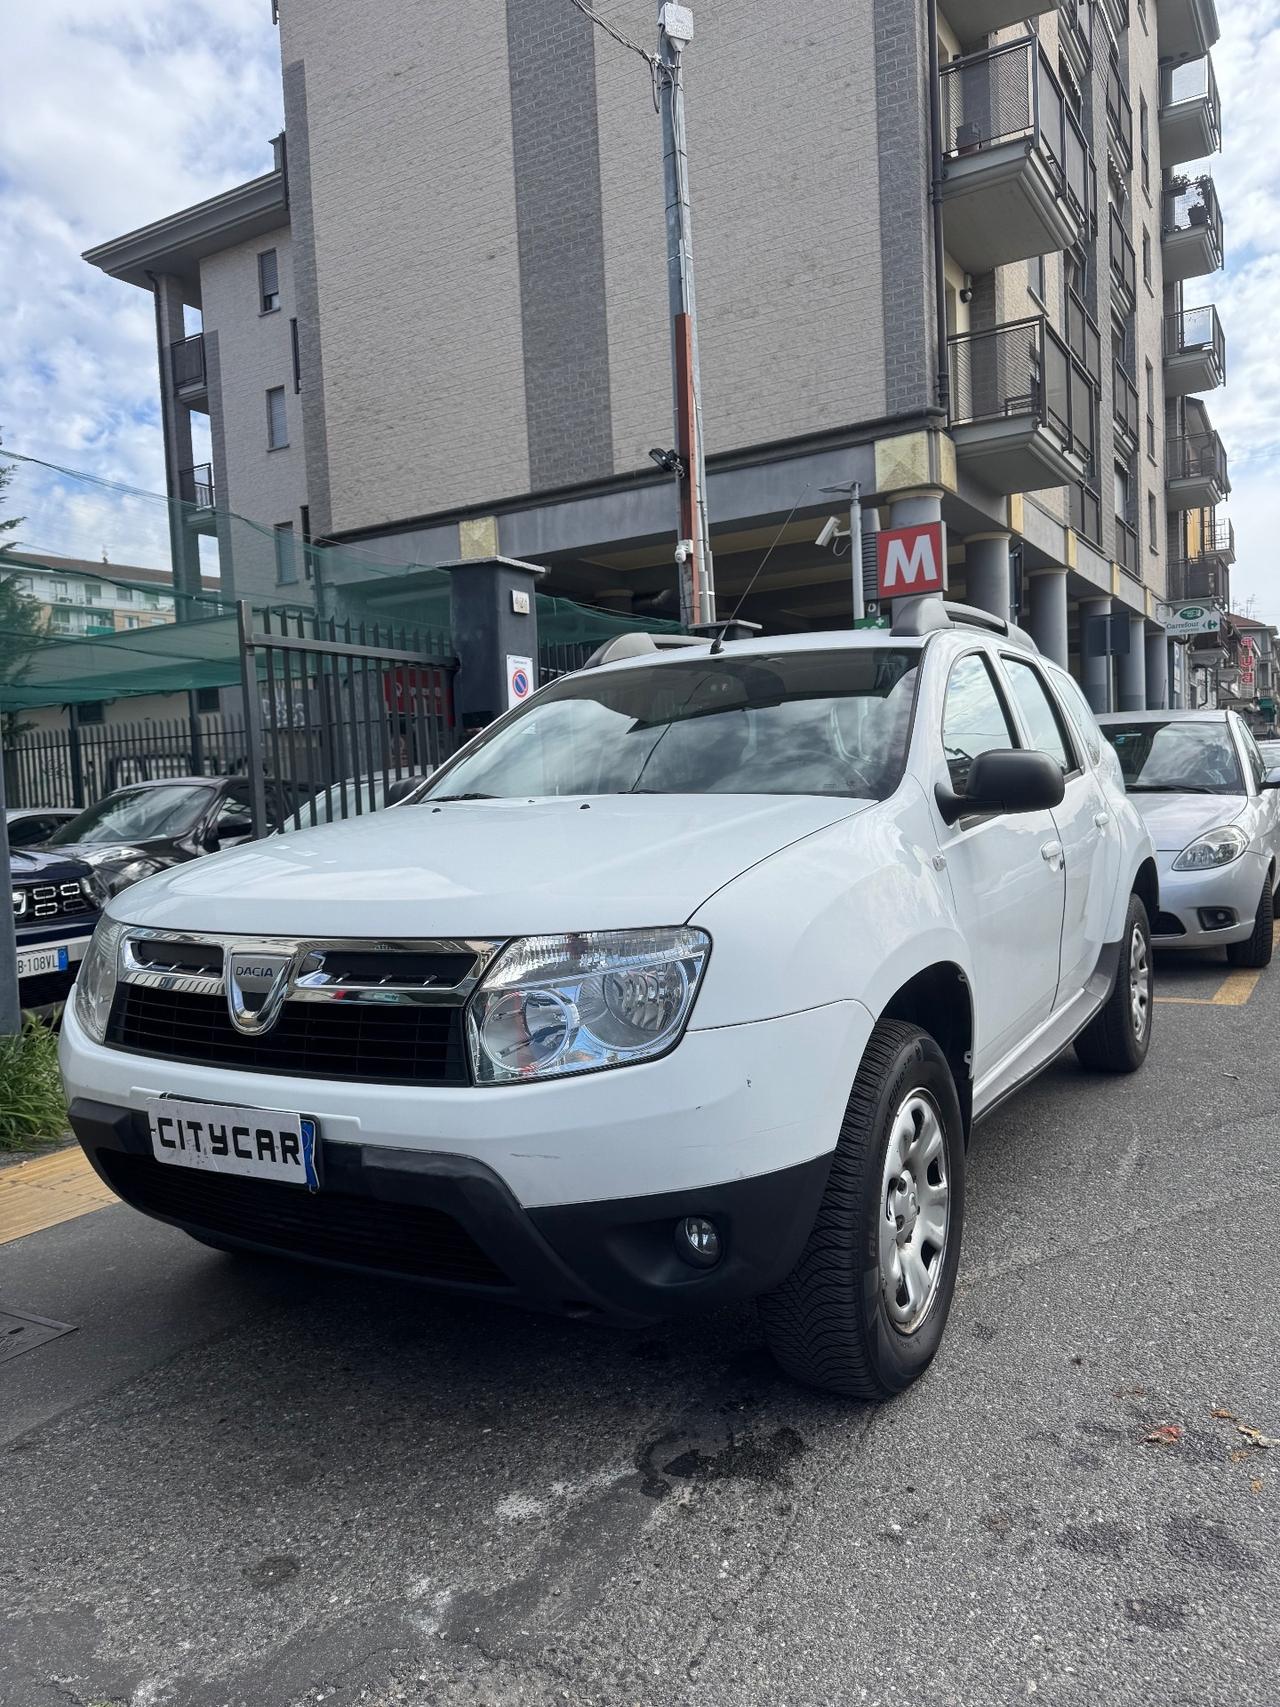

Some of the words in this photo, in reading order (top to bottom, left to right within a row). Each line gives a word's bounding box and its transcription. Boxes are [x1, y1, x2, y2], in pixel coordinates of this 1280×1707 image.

[884, 534, 938, 587] M
[236, 966, 273, 977] DACIA
[157, 1117, 301, 1166] CITYCAR
